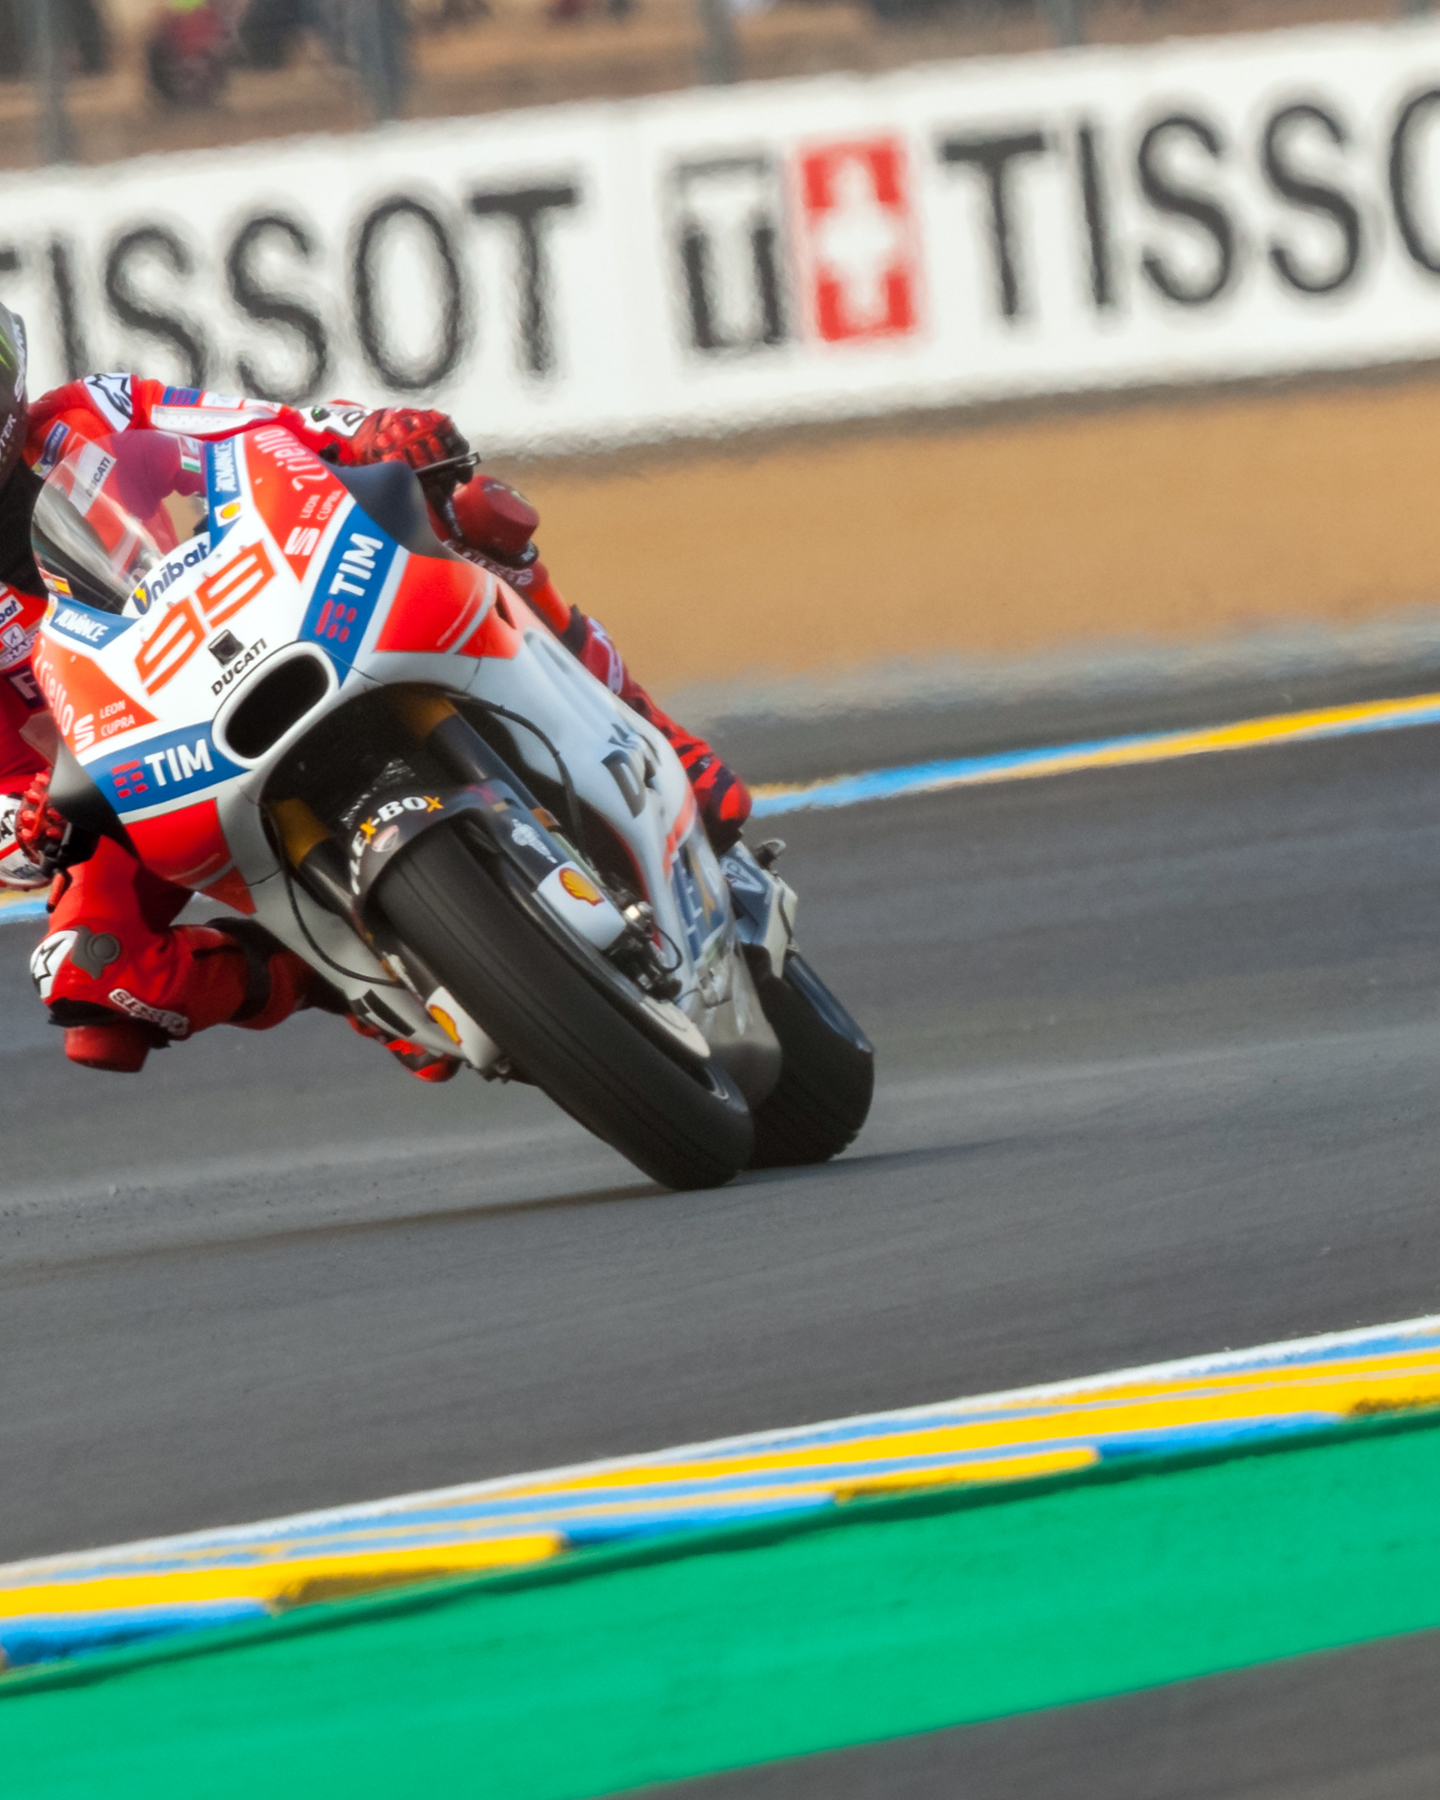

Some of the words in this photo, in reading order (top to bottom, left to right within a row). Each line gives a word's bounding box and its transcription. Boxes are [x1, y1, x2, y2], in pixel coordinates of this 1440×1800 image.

[132, 542, 209, 615] Unibat
[328, 532, 384, 597] TIM
[54, 608, 109, 643] ADVANCE
[133, 539, 277, 697] 99
[210, 638, 268, 697] DUCATI
[99, 698, 126, 720] LEON
[100, 714, 136, 738] CUPRA
[143, 738, 214, 787] TIM
